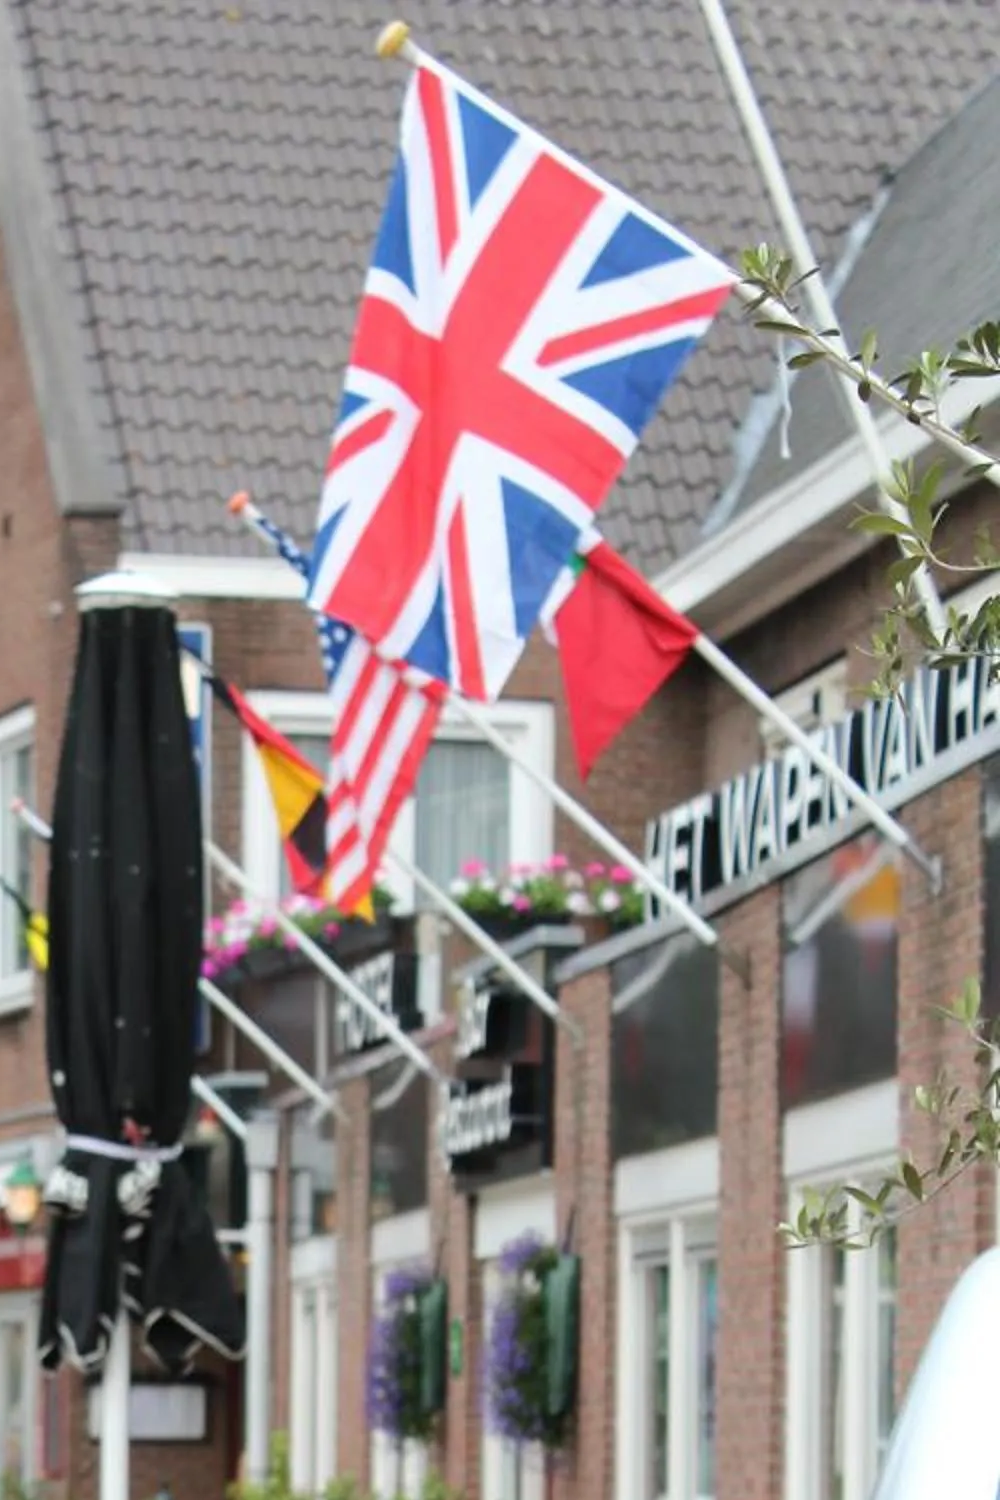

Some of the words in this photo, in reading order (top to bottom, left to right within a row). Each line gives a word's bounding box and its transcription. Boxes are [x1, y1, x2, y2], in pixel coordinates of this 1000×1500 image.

[646, 793, 712, 917] HET
[720, 711, 851, 885] WAPEN
[862, 665, 939, 797] VAN
